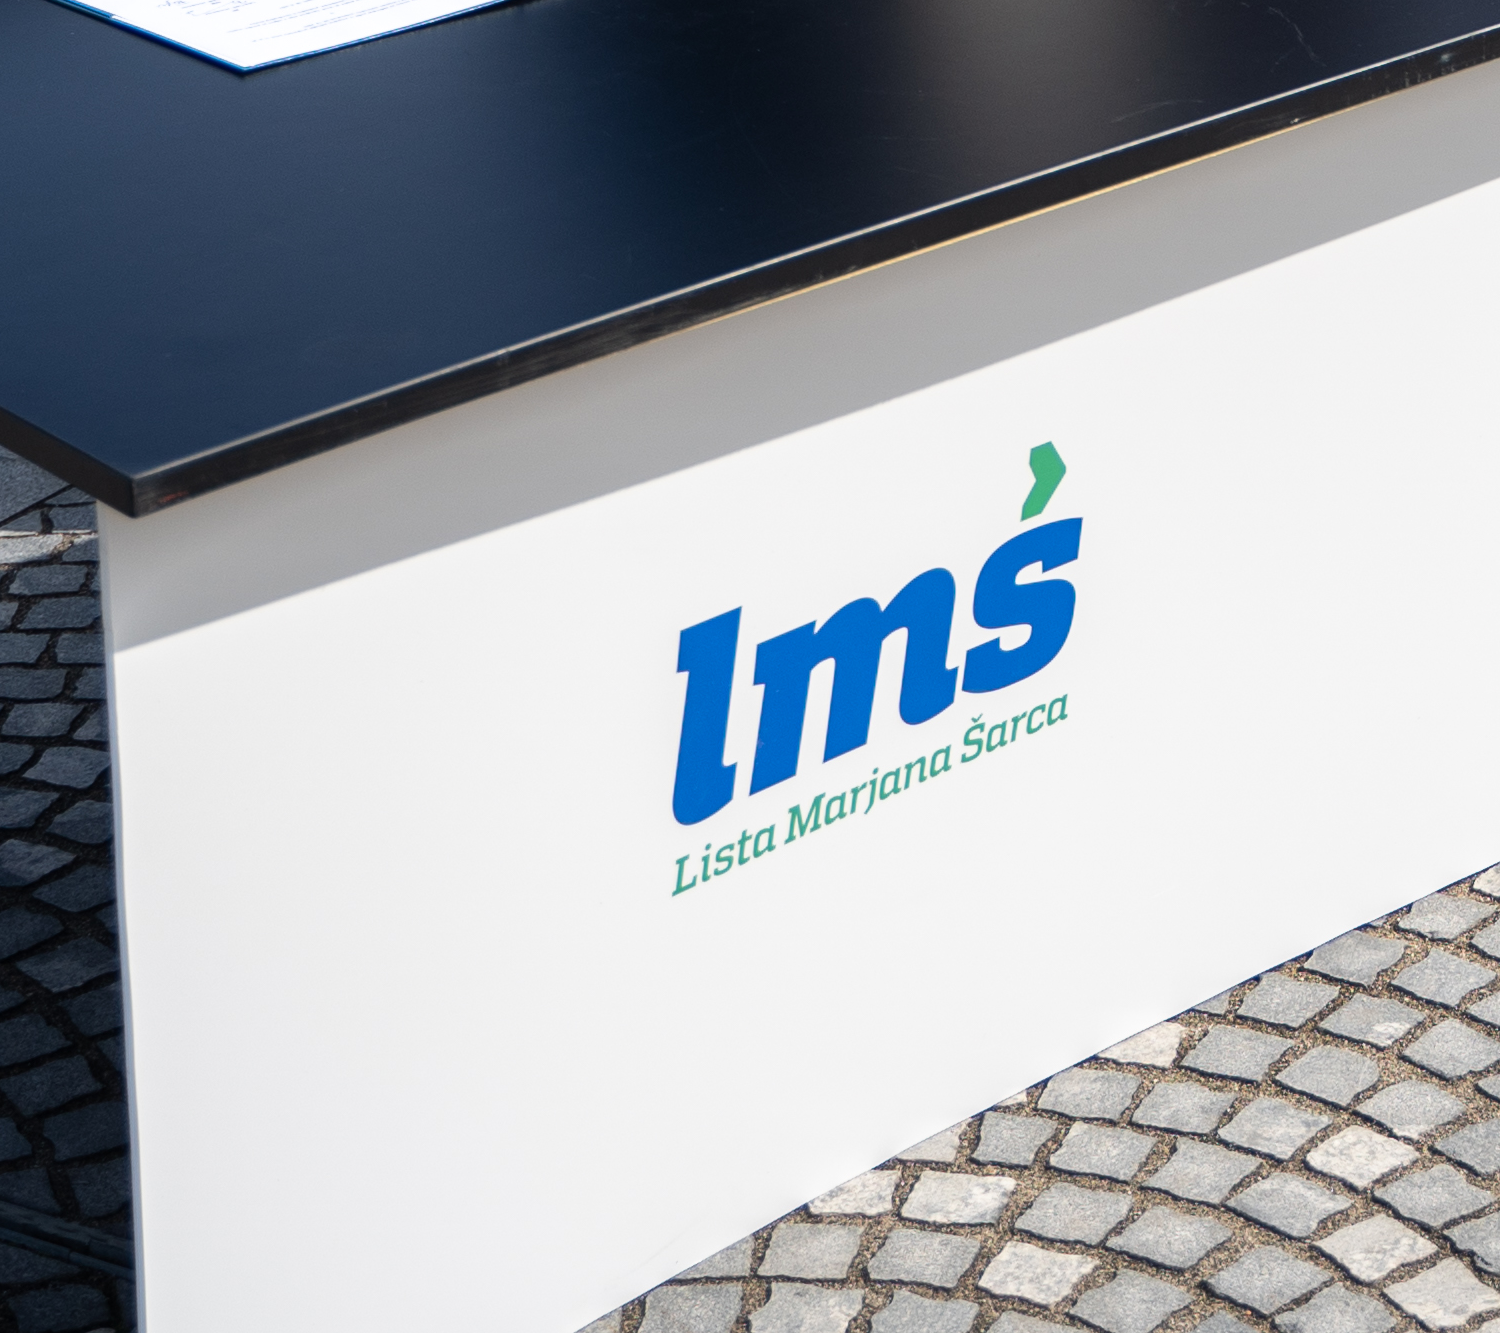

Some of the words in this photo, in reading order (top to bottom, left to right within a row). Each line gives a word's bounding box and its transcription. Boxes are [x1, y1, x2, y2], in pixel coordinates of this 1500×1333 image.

[672, 823, 776, 897] Lista
[784, 743, 952, 845] Marjana
[960, 693, 1069, 764] Šarca
